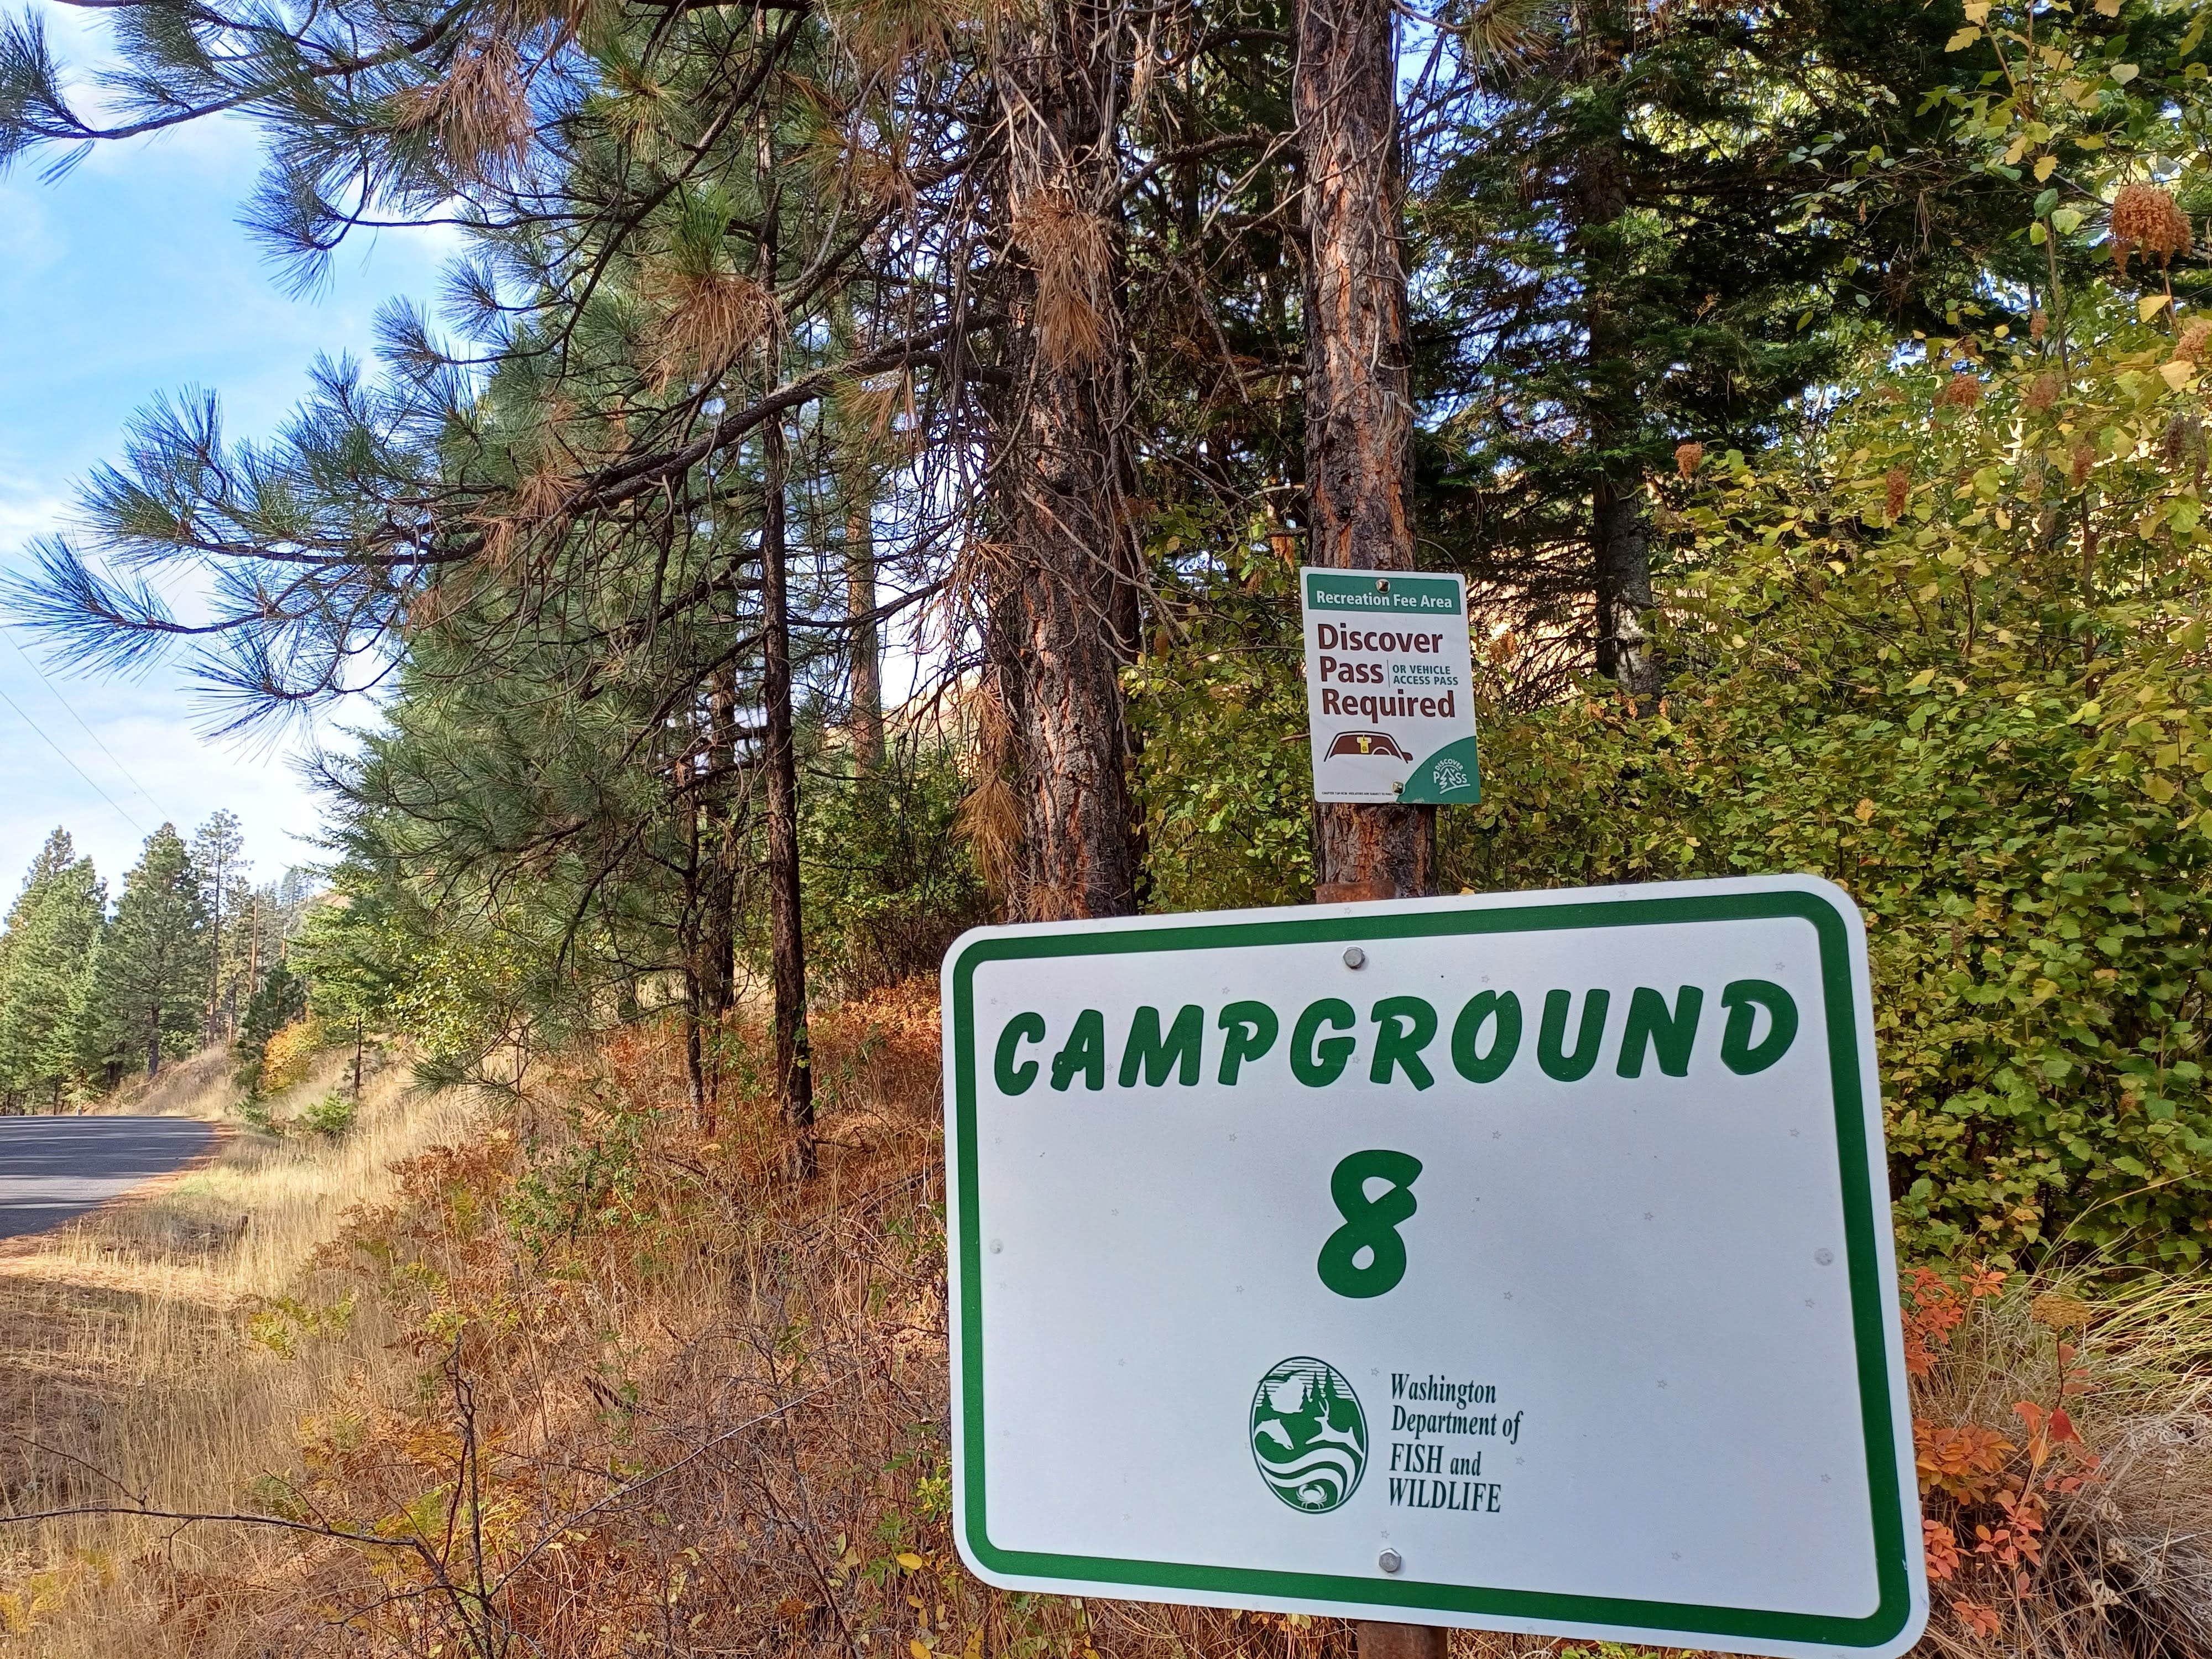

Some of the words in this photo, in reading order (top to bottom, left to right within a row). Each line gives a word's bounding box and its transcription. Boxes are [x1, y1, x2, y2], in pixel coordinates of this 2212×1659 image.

[1316, 590, 1390, 606] Recreation
[1394, 594, 1417, 607] Fee
[1420, 595, 1453, 608] Area
[1318, 623, 1443, 653] Discover
[1320, 656, 1384, 683] Pass
[1392, 665, 1406, 674] OR
[1410, 665, 1451, 675] VEHICLE
[1393, 675, 1431, 685] ACCESS
[1434, 676, 1458, 686] PASS
[1322, 688, 1455, 723] Required
[1434, 758, 1463, 771] DISCOVER
[994, 979, 1799, 1096] CAMPGROUND
[1317, 1150, 1423, 1298] 8
[1391, 1373, 1496, 1410] Washington
[1391, 1405, 1496, 1439] Department
[1503, 1410, 1524, 1444] of
[1389, 1443, 1444, 1474] FISH
[1450, 1452, 1481, 1477] and
[1389, 1478, 1501, 1512] WILDLIFE
